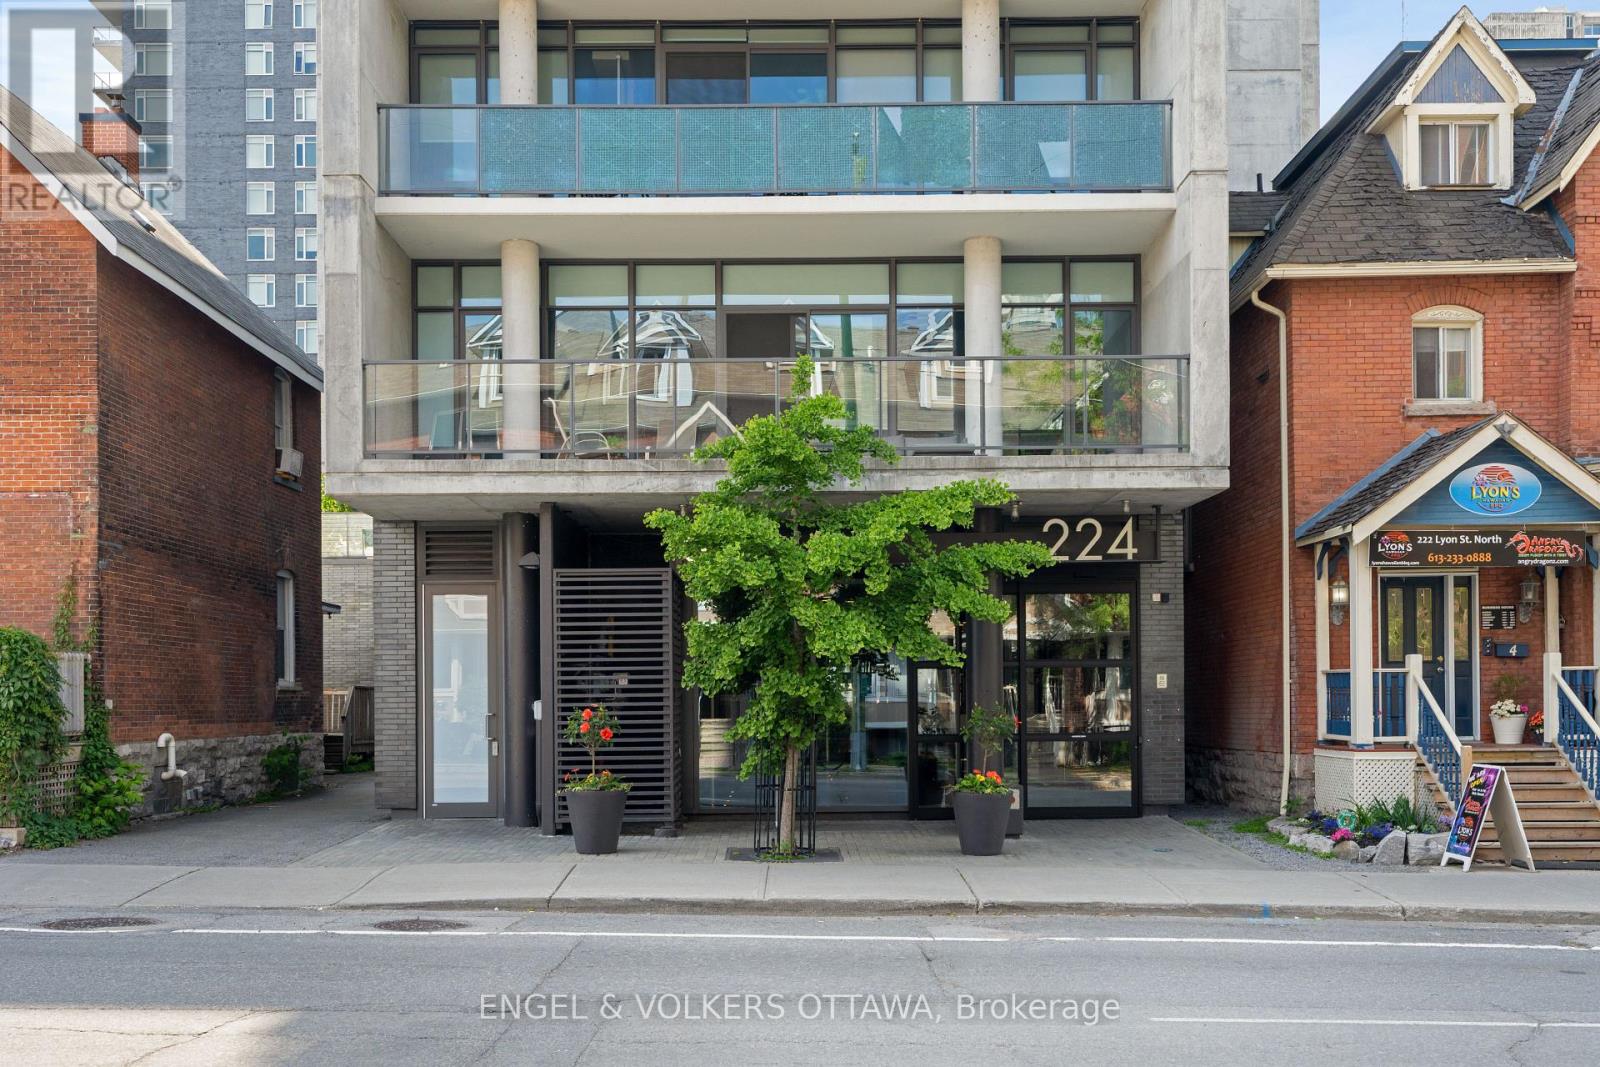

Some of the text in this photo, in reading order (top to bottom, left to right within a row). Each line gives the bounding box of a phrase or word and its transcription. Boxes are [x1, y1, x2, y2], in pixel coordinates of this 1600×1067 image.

[1471, 485, 1521, 500] LYON'S
[1042, 515, 1138, 560] 224
[1417, 535, 1502, 546] 222 Lyon St. North
[1531, 536, 1562, 545] ANGRY
[1427, 552, 1492, 565] 613-233-0888
[1518, 558, 1569, 566] angrydragonz.com
[1509, 644, 1518, 657] 4
